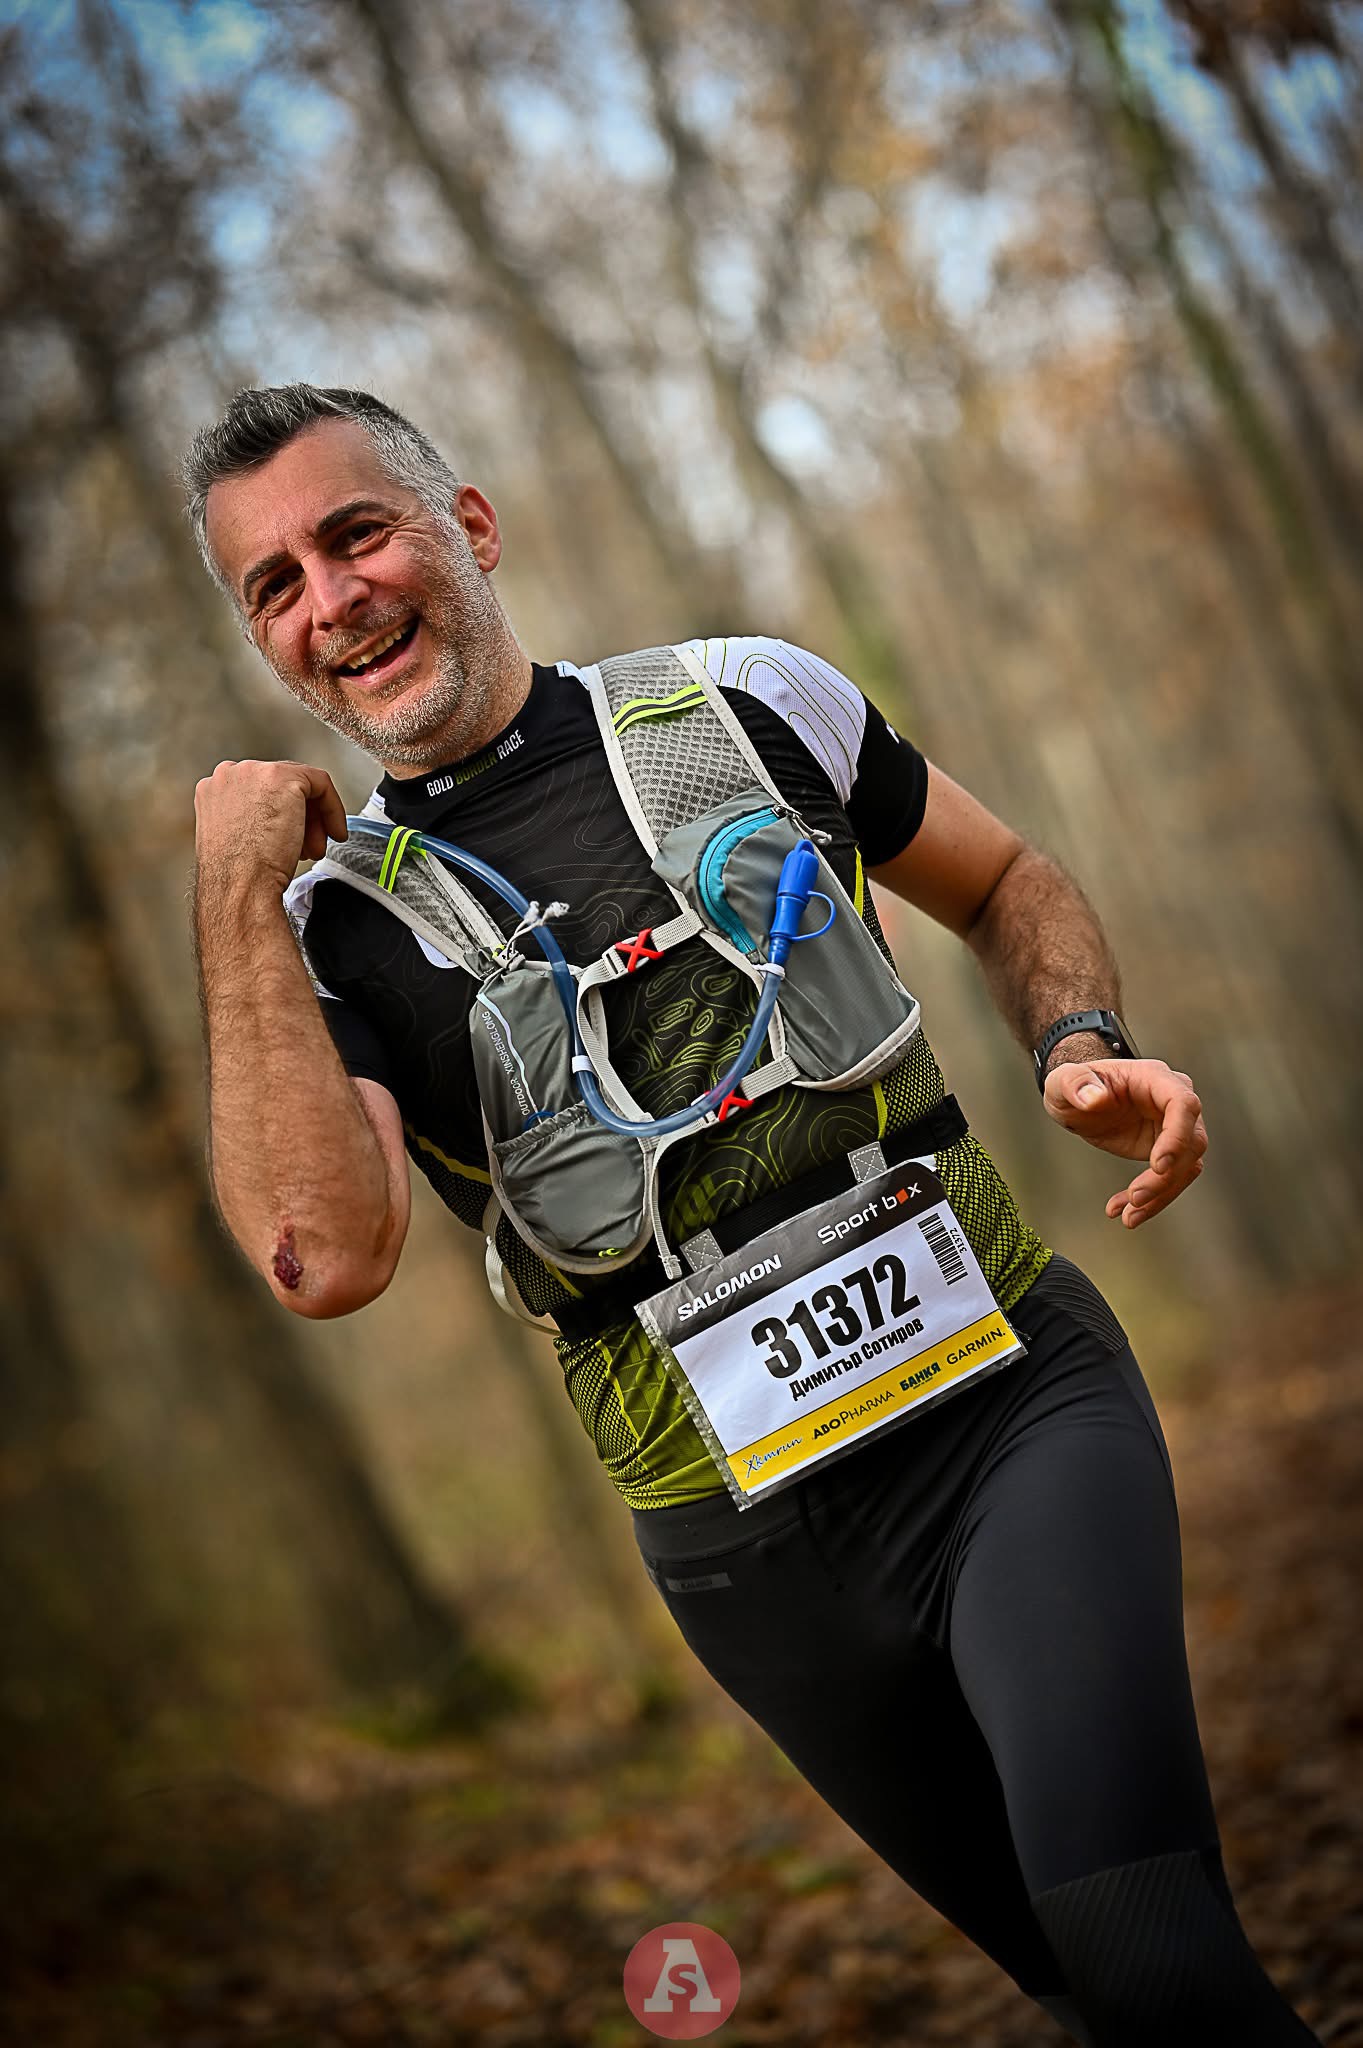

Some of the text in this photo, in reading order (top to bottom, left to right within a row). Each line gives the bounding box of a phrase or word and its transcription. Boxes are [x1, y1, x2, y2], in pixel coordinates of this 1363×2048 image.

[426, 729, 525, 797] GOLD BORDER RACE
[481, 1010, 531, 1116] OUTDOOR XINSHENGLONG
[817, 1202, 880, 1245] Sport
[950, 1227, 968, 1254] 31372
[677, 1253, 783, 1321] SALOMON
[750, 1254, 921, 1379] 31372
[788, 1318, 923, 1401] Димитър Сотиров
[899, 1361, 942, 1392] БАНКЯ
